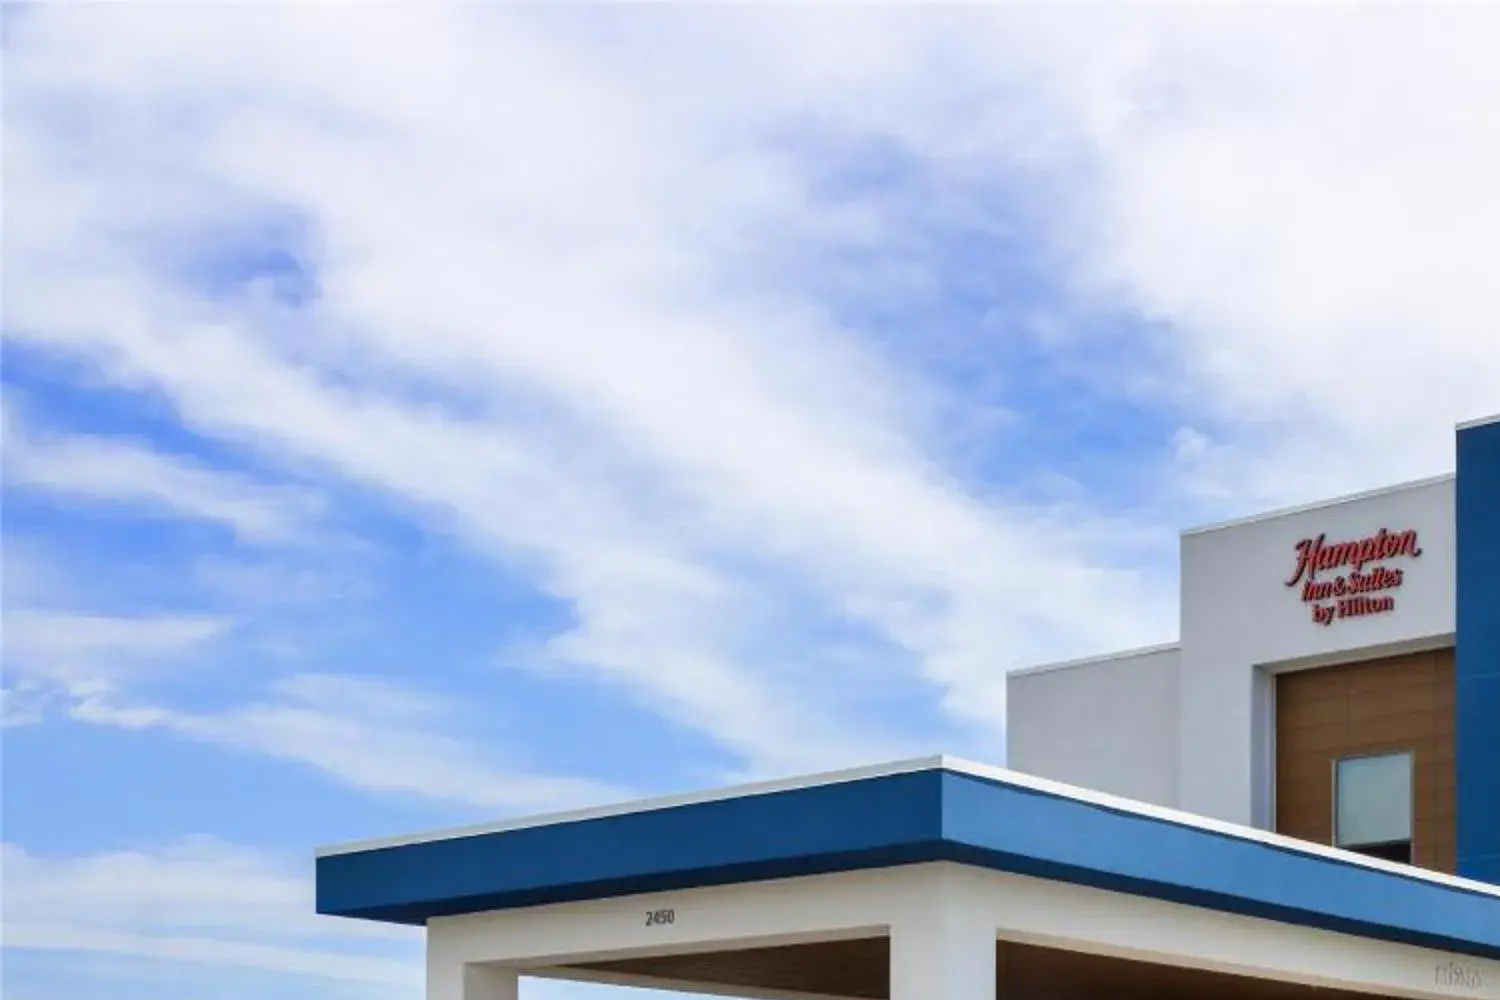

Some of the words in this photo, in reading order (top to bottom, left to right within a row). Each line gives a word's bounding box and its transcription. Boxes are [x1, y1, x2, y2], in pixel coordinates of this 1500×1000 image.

[1284, 528, 1423, 587] Hampton
[1312, 604, 1334, 626] by
[1337, 596, 1395, 619] Hilton
[645, 910, 675, 927] 2450
